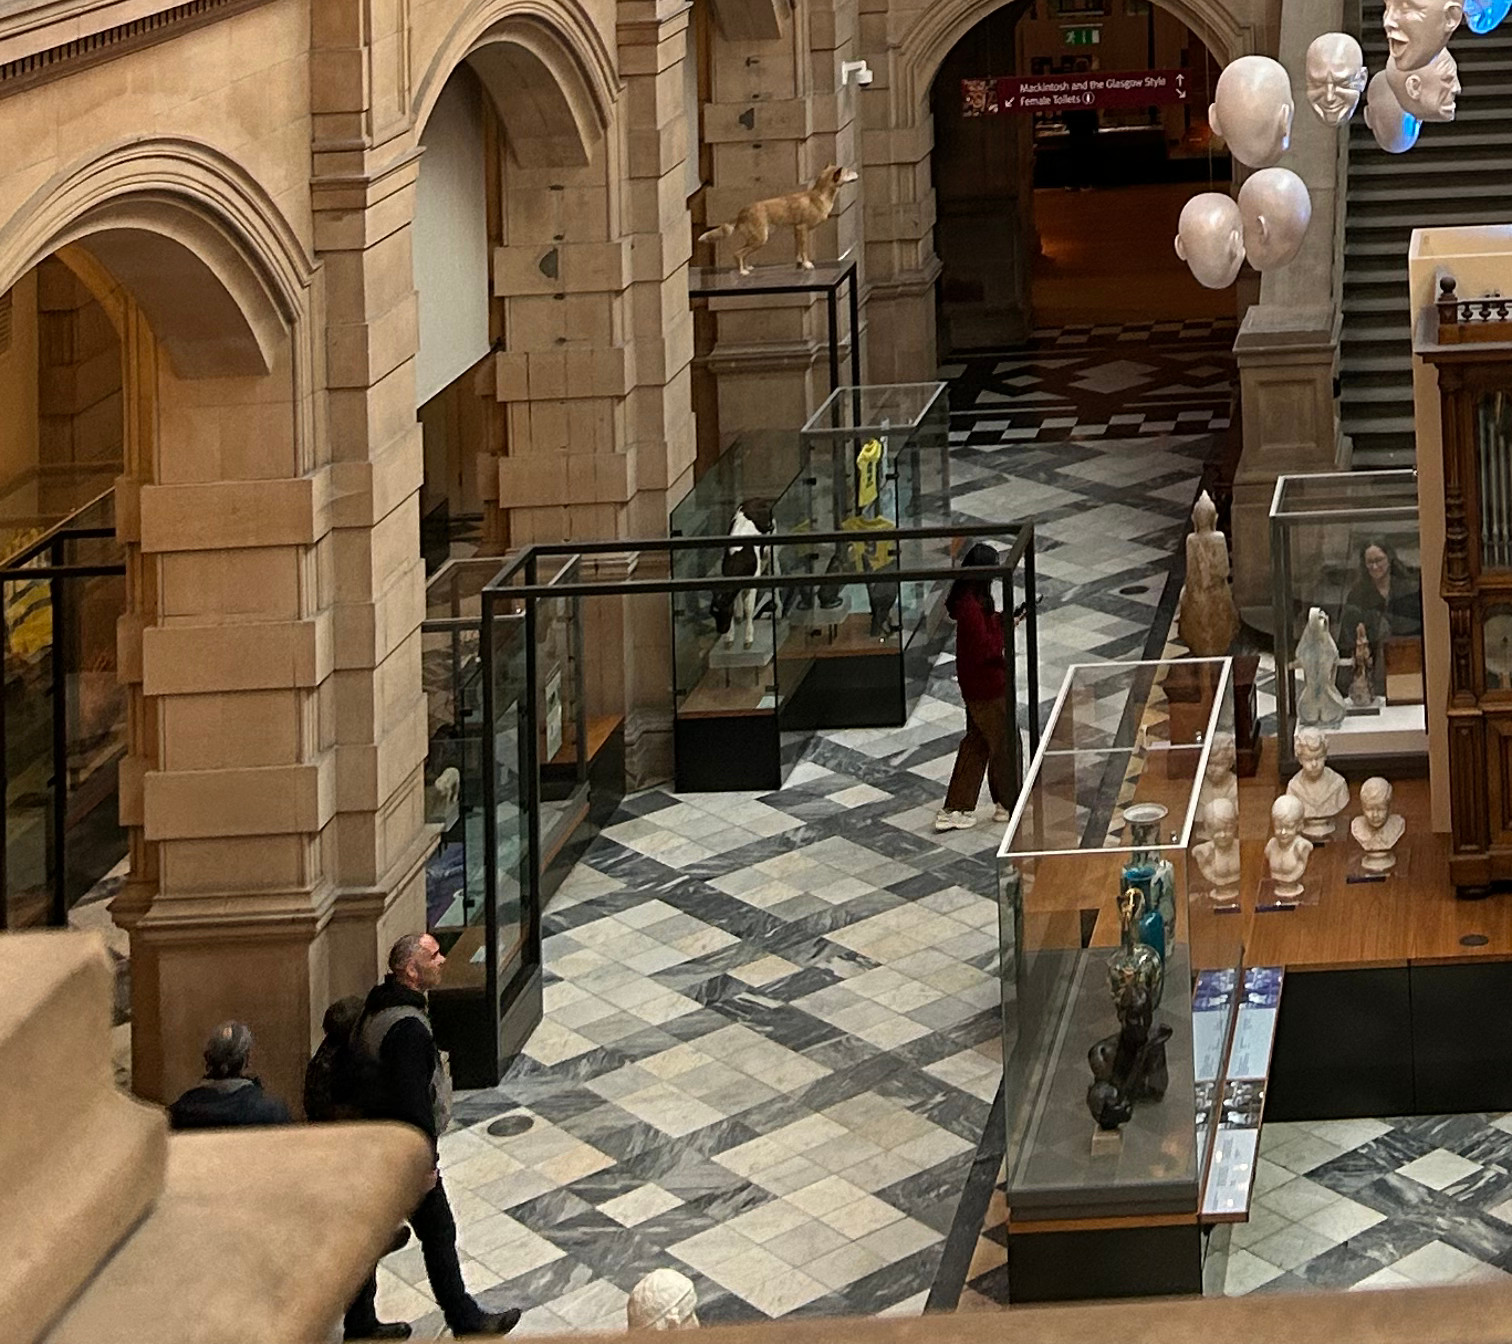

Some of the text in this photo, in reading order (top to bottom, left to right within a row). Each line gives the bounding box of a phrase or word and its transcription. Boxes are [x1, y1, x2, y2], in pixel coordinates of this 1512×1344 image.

[1019, 76, 1167, 93] Mackintosh and the Glasgow Style
[1019, 94, 1082, 107] Female Toilets
